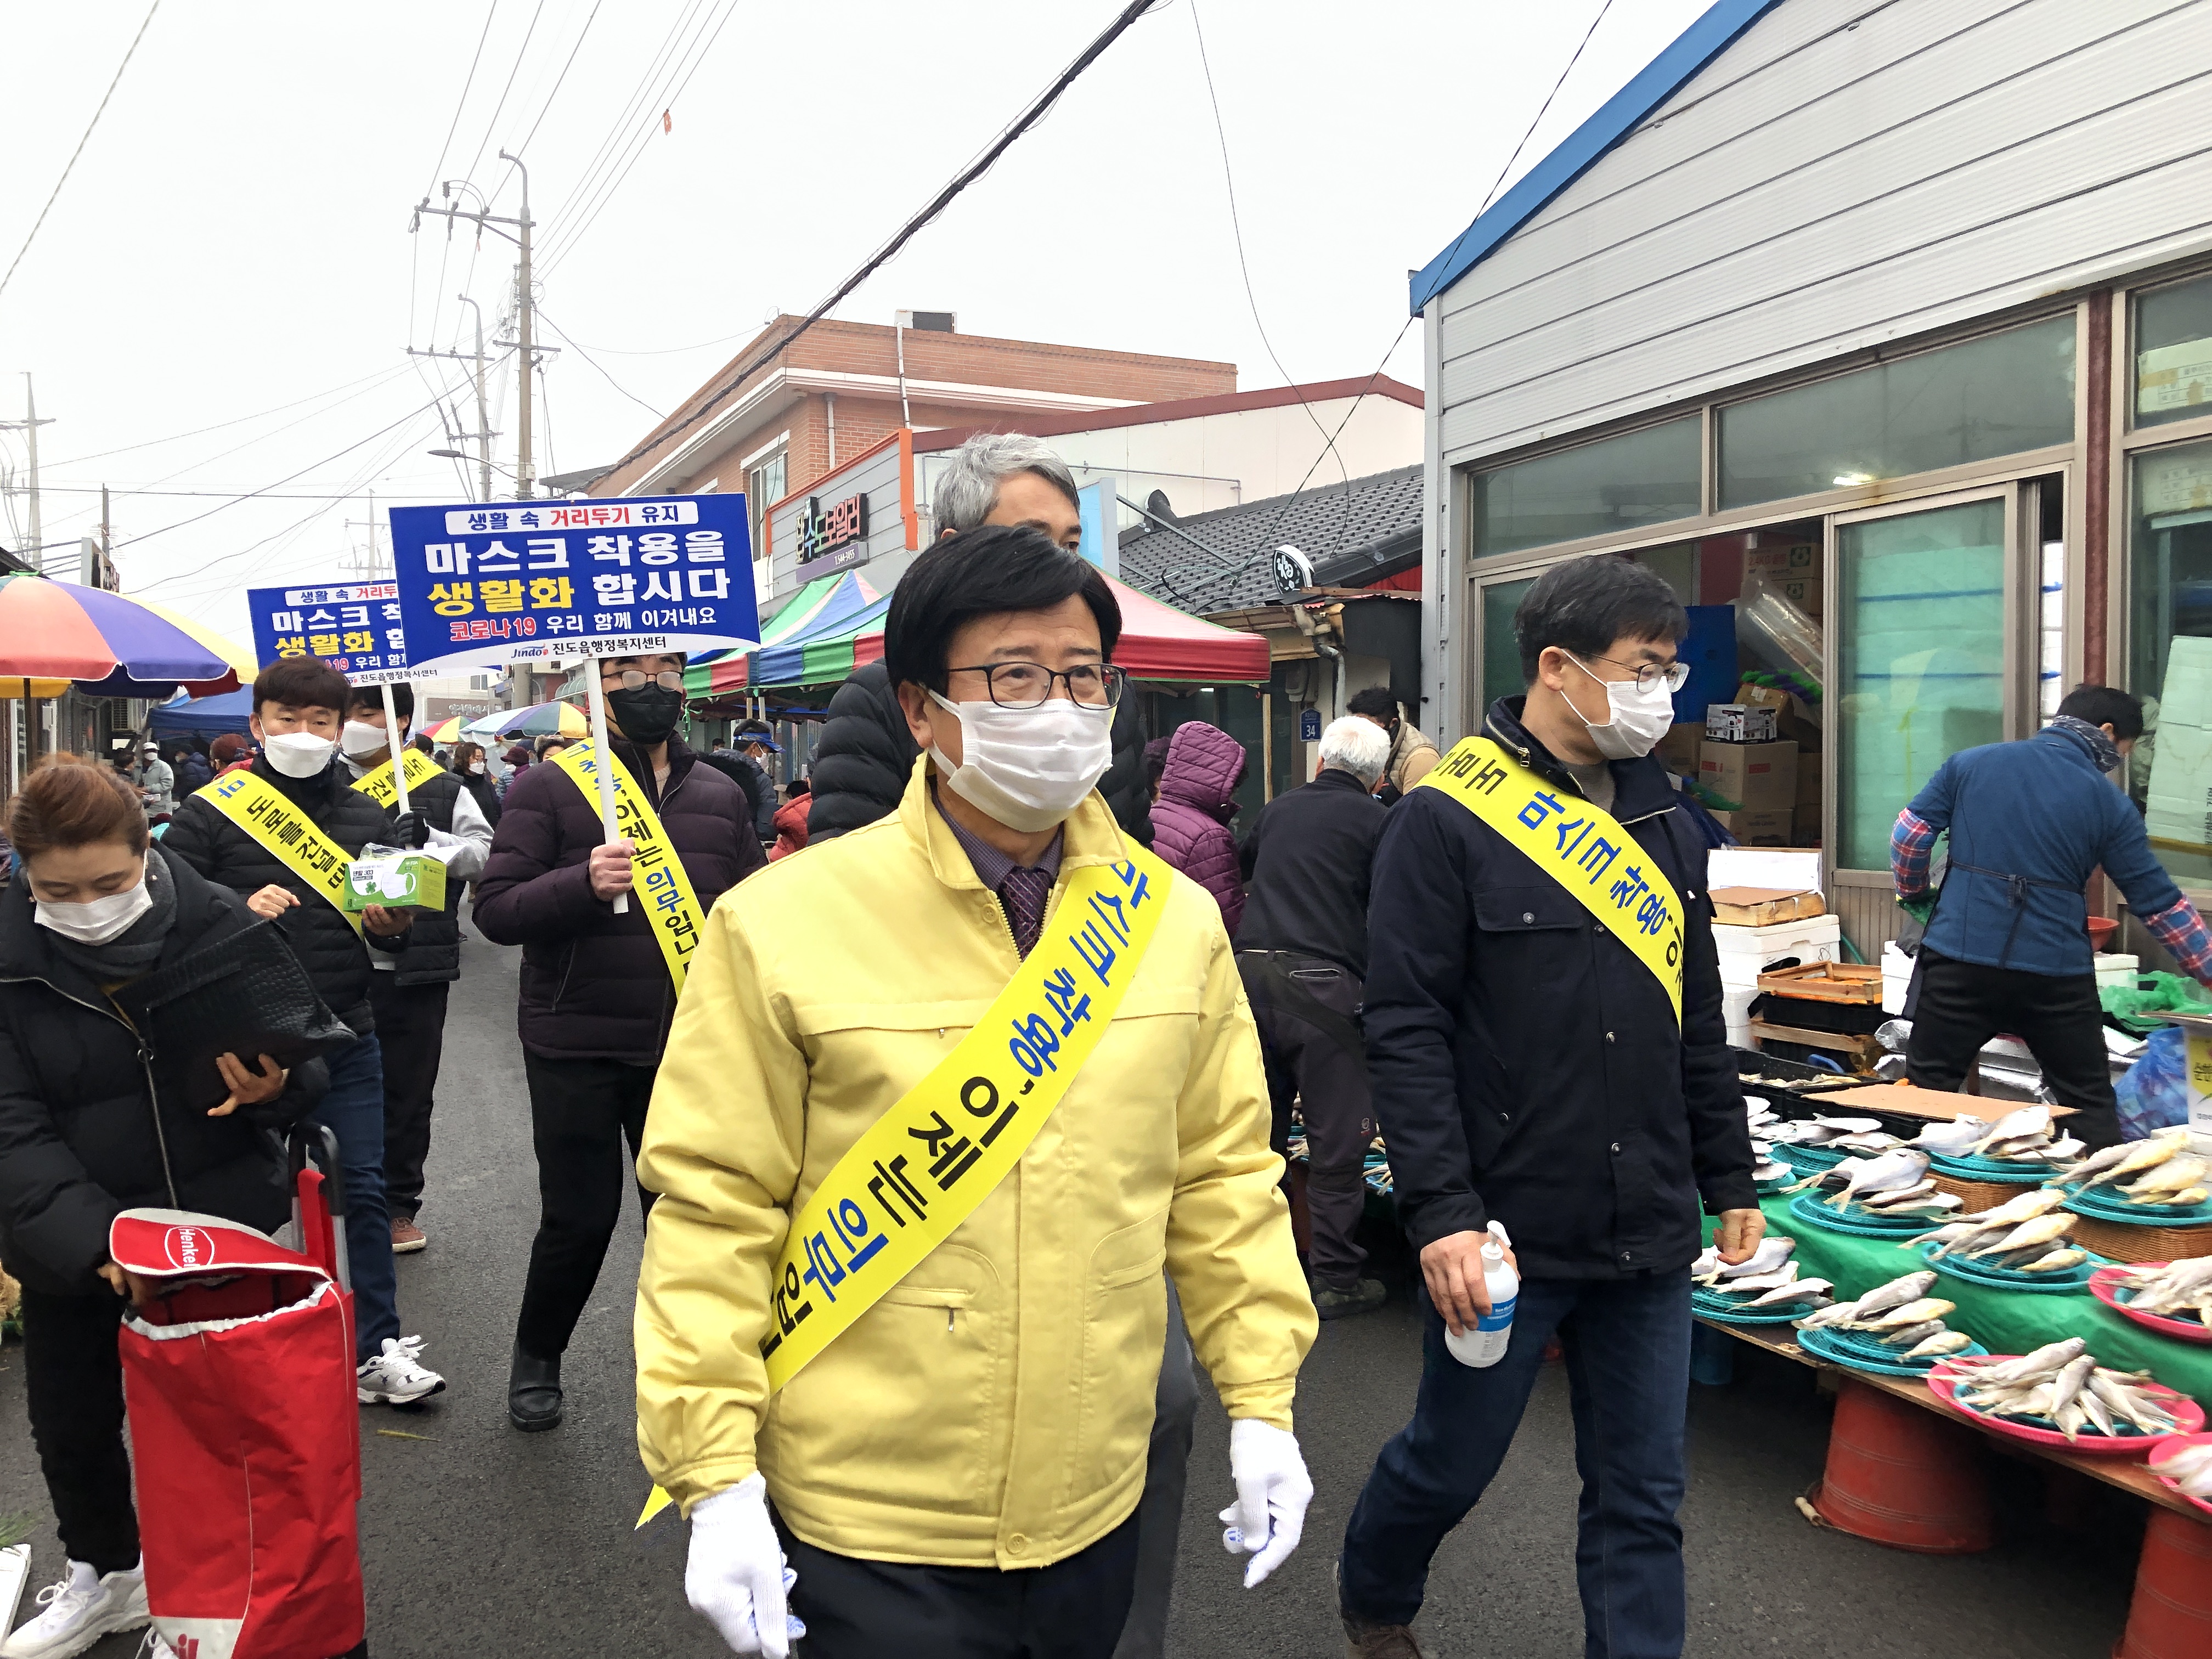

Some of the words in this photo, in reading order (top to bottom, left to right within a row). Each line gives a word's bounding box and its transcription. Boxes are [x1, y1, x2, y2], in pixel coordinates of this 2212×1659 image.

[468, 512, 508, 530] 생활
[521, 511, 539, 529] 속
[550, 508, 630, 527] 거리두기
[641, 505, 679, 524] 유지
[425, 537, 569, 575] 마스크
[587, 531, 726, 567] 착용을
[300, 590, 328, 603] 생활
[336, 589, 348, 600] 속
[356, 585, 397, 599] 거리두
[426, 577, 575, 617] 생활화
[592, 568, 730, 605] 합시다
[272, 607, 370, 632] 마스크
[450, 618, 537, 642] 코로나19
[546, 615, 583, 634] 우리
[594, 611, 631, 631] 함께
[641, 607, 717, 628] 이겨내요
[274, 631, 374, 659] 생활화
[356, 655, 381, 668] 우리
[552, 635, 667, 656] 진도읍행정복지센터
[1306, 725, 1316, 737] 34
[246, 795, 306, 848] 도로를
[295, 836, 338, 873] 건널
[617, 799, 663, 868] 이제는
[1517, 791, 1622, 885] 마스크
[1610, 865, 1674, 935] 착용,
[1069, 856, 1151, 988] 마스크
[1010, 967, 1092, 1096] 착용,
[866, 1076, 1019, 1229] 이제는
[759, 1197, 889, 1360] 의무입
